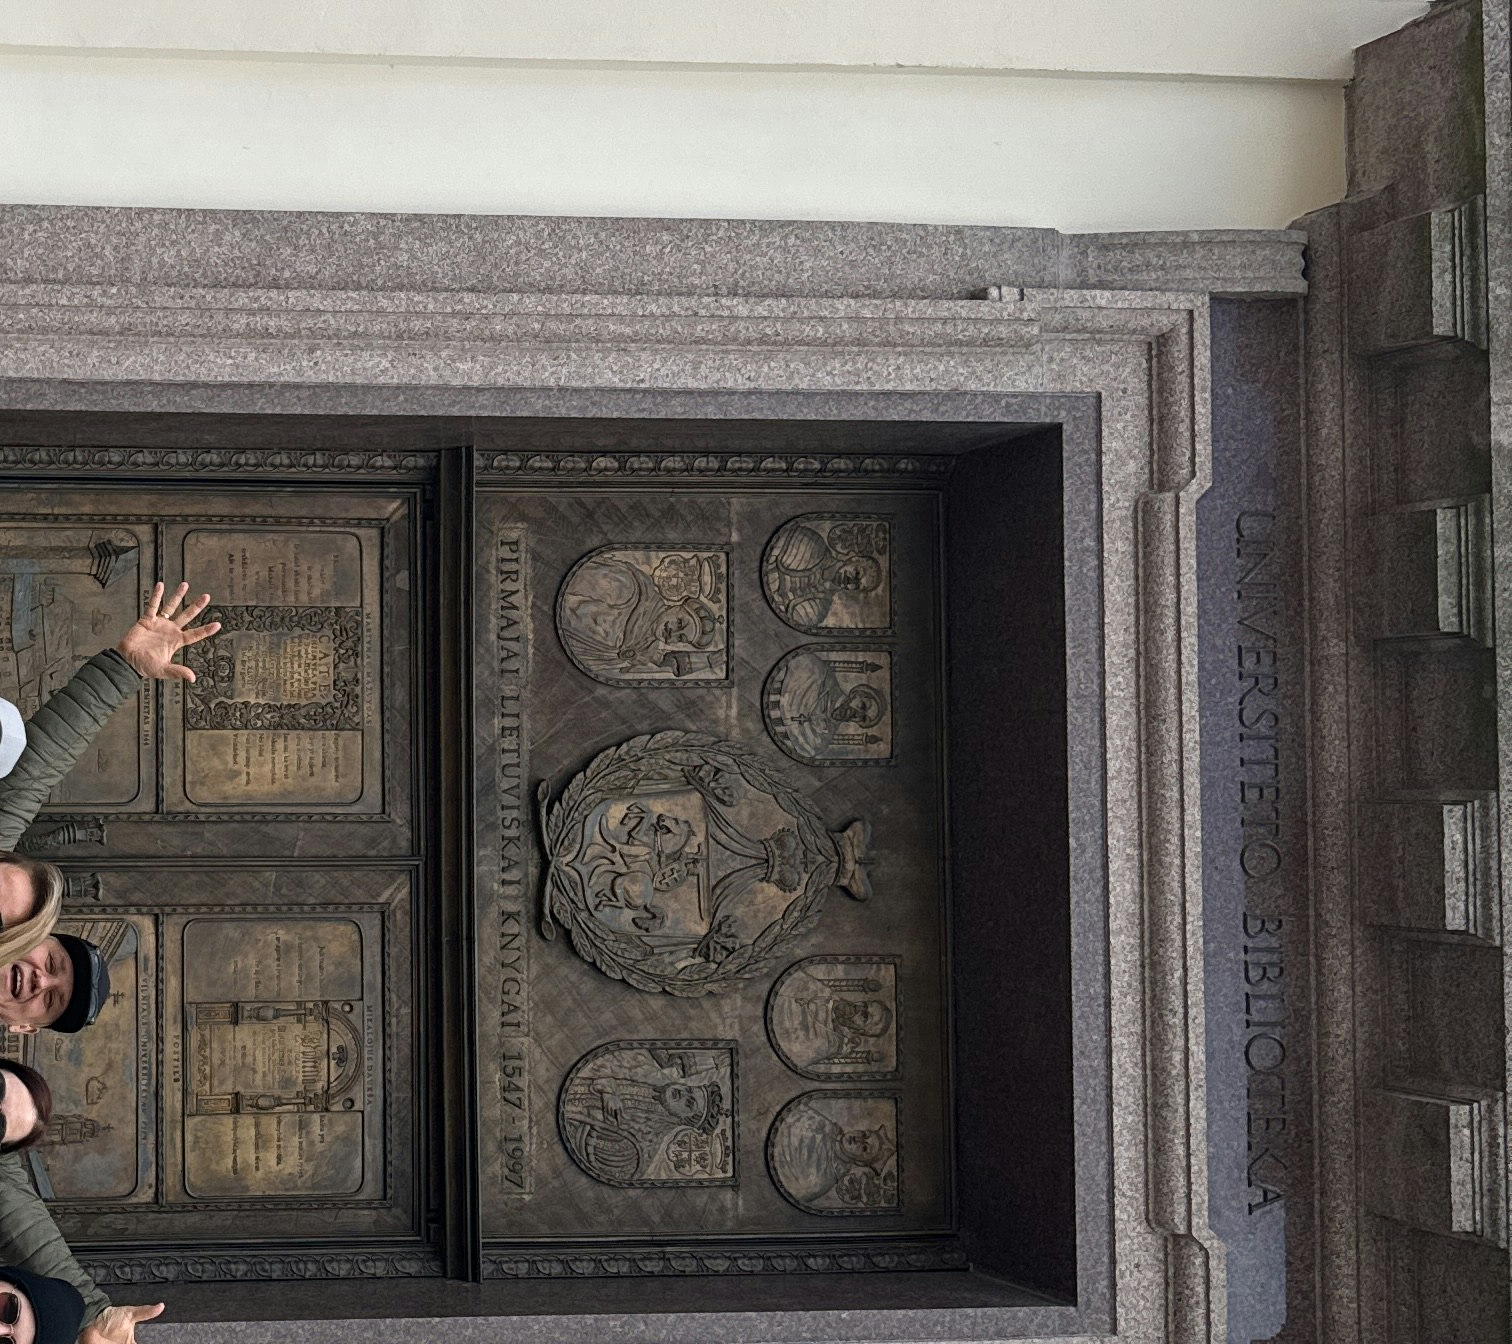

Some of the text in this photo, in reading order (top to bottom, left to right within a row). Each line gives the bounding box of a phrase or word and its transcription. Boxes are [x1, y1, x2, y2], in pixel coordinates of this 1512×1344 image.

[498, 539, 520, 677] PIRMAJAI
[499, 695, 526, 888] LIETUVIŠKAI
[1236, 510, 1288, 1216] UNIVERSITETO BIBLIOTEKA
[500, 909, 521, 1030] KNYGAI
[502, 1052, 524, 1113] 1547
[503, 1134, 525, 1190] 1997
